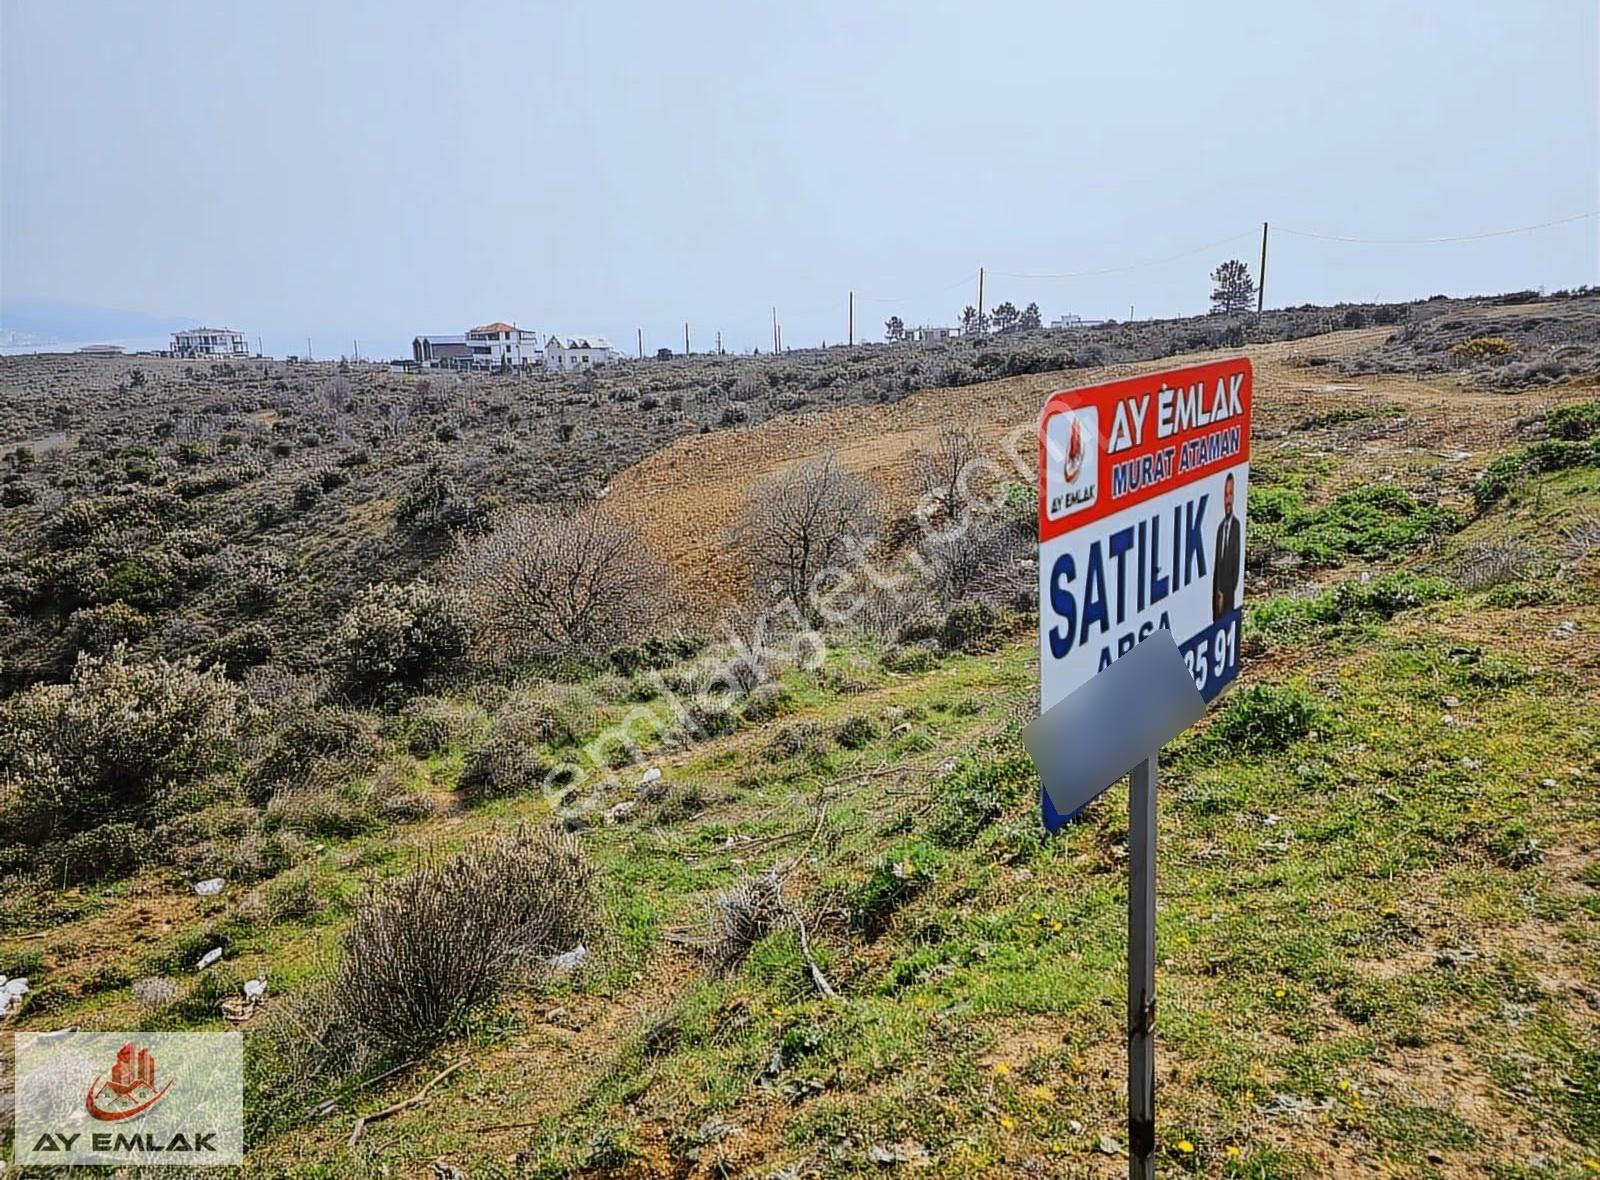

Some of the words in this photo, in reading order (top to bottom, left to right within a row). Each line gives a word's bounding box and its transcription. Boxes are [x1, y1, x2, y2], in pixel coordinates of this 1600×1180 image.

[1108, 394, 1150, 454] AY
[1112, 448, 1175, 500] MURAT
[1178, 425, 1241, 475] ATAMAN
[1049, 493, 1209, 660] SATILIK
[1214, 620, 1236, 678] 91
